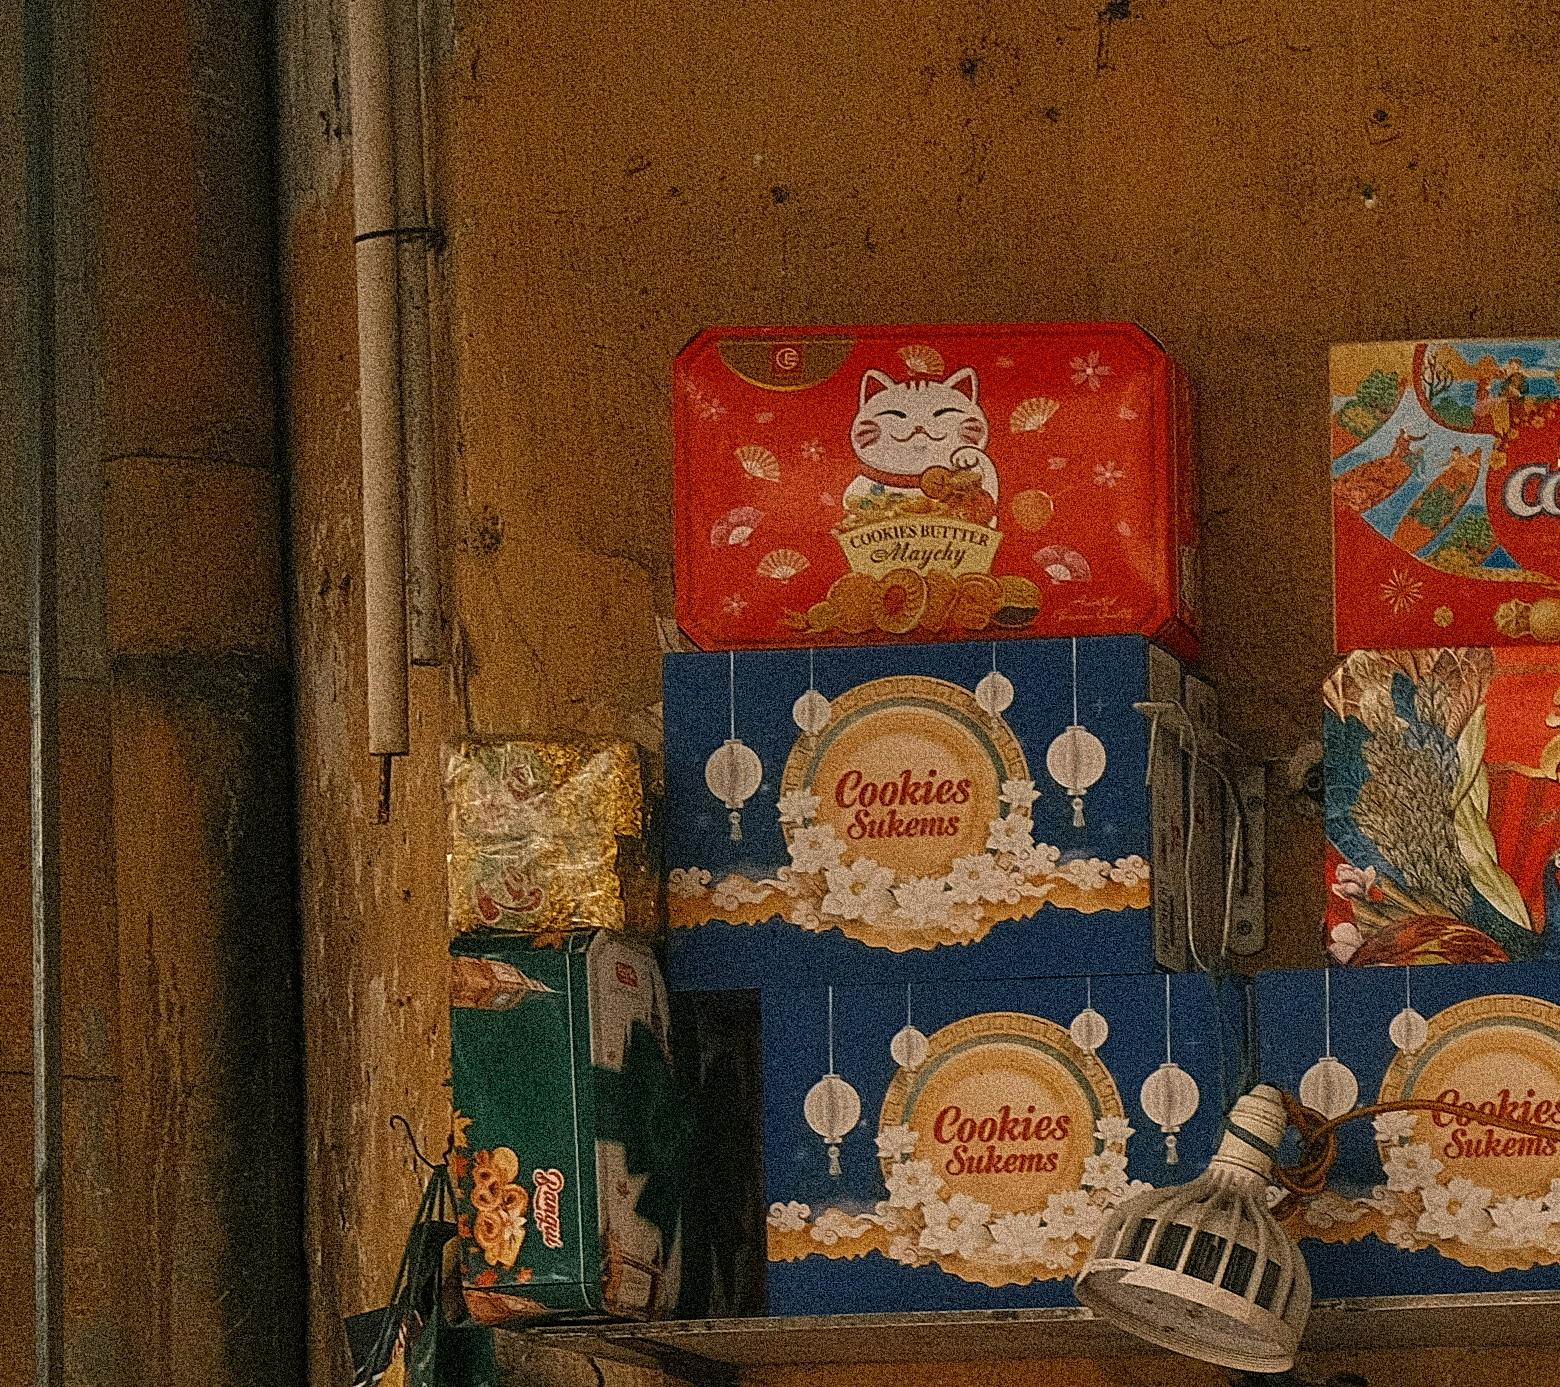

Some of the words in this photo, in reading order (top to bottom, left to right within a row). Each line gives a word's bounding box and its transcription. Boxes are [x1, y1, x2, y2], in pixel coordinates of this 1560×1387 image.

[849, 521, 917, 550] COOKIES
[834, 768, 972, 809] Cookies
[846, 809, 960, 840] Sukems
[932, 1104, 1070, 1146] Cookies
[944, 1145, 1060, 1175] Sukems
